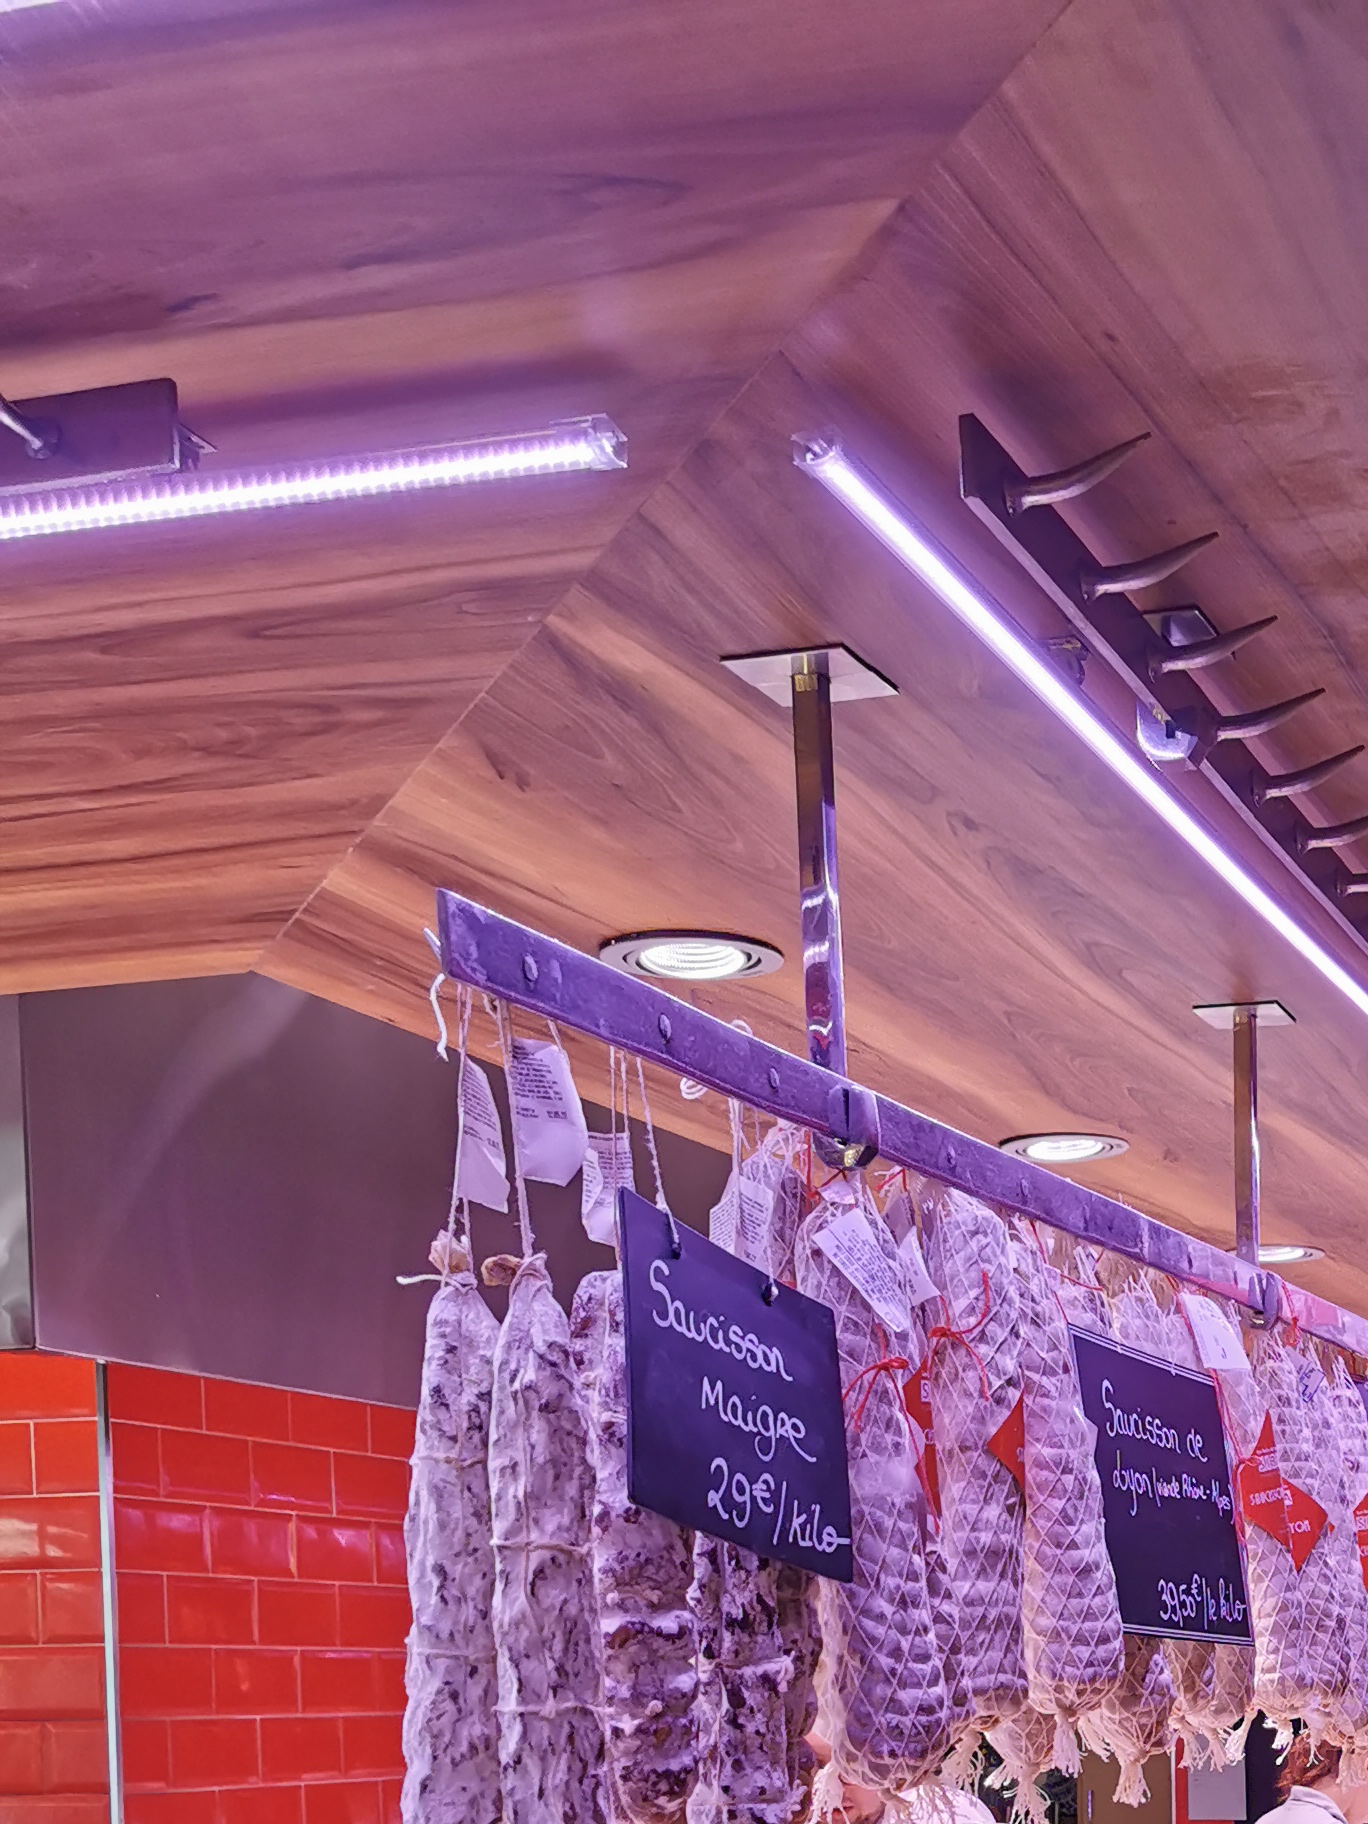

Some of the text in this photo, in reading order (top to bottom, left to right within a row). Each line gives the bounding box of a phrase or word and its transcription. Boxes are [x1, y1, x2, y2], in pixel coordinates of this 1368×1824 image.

[650, 1259, 793, 1382] Saucisson
[702, 1376, 817, 1463] Maigre
[1102, 1378, 1208, 1463] Saucisson de
